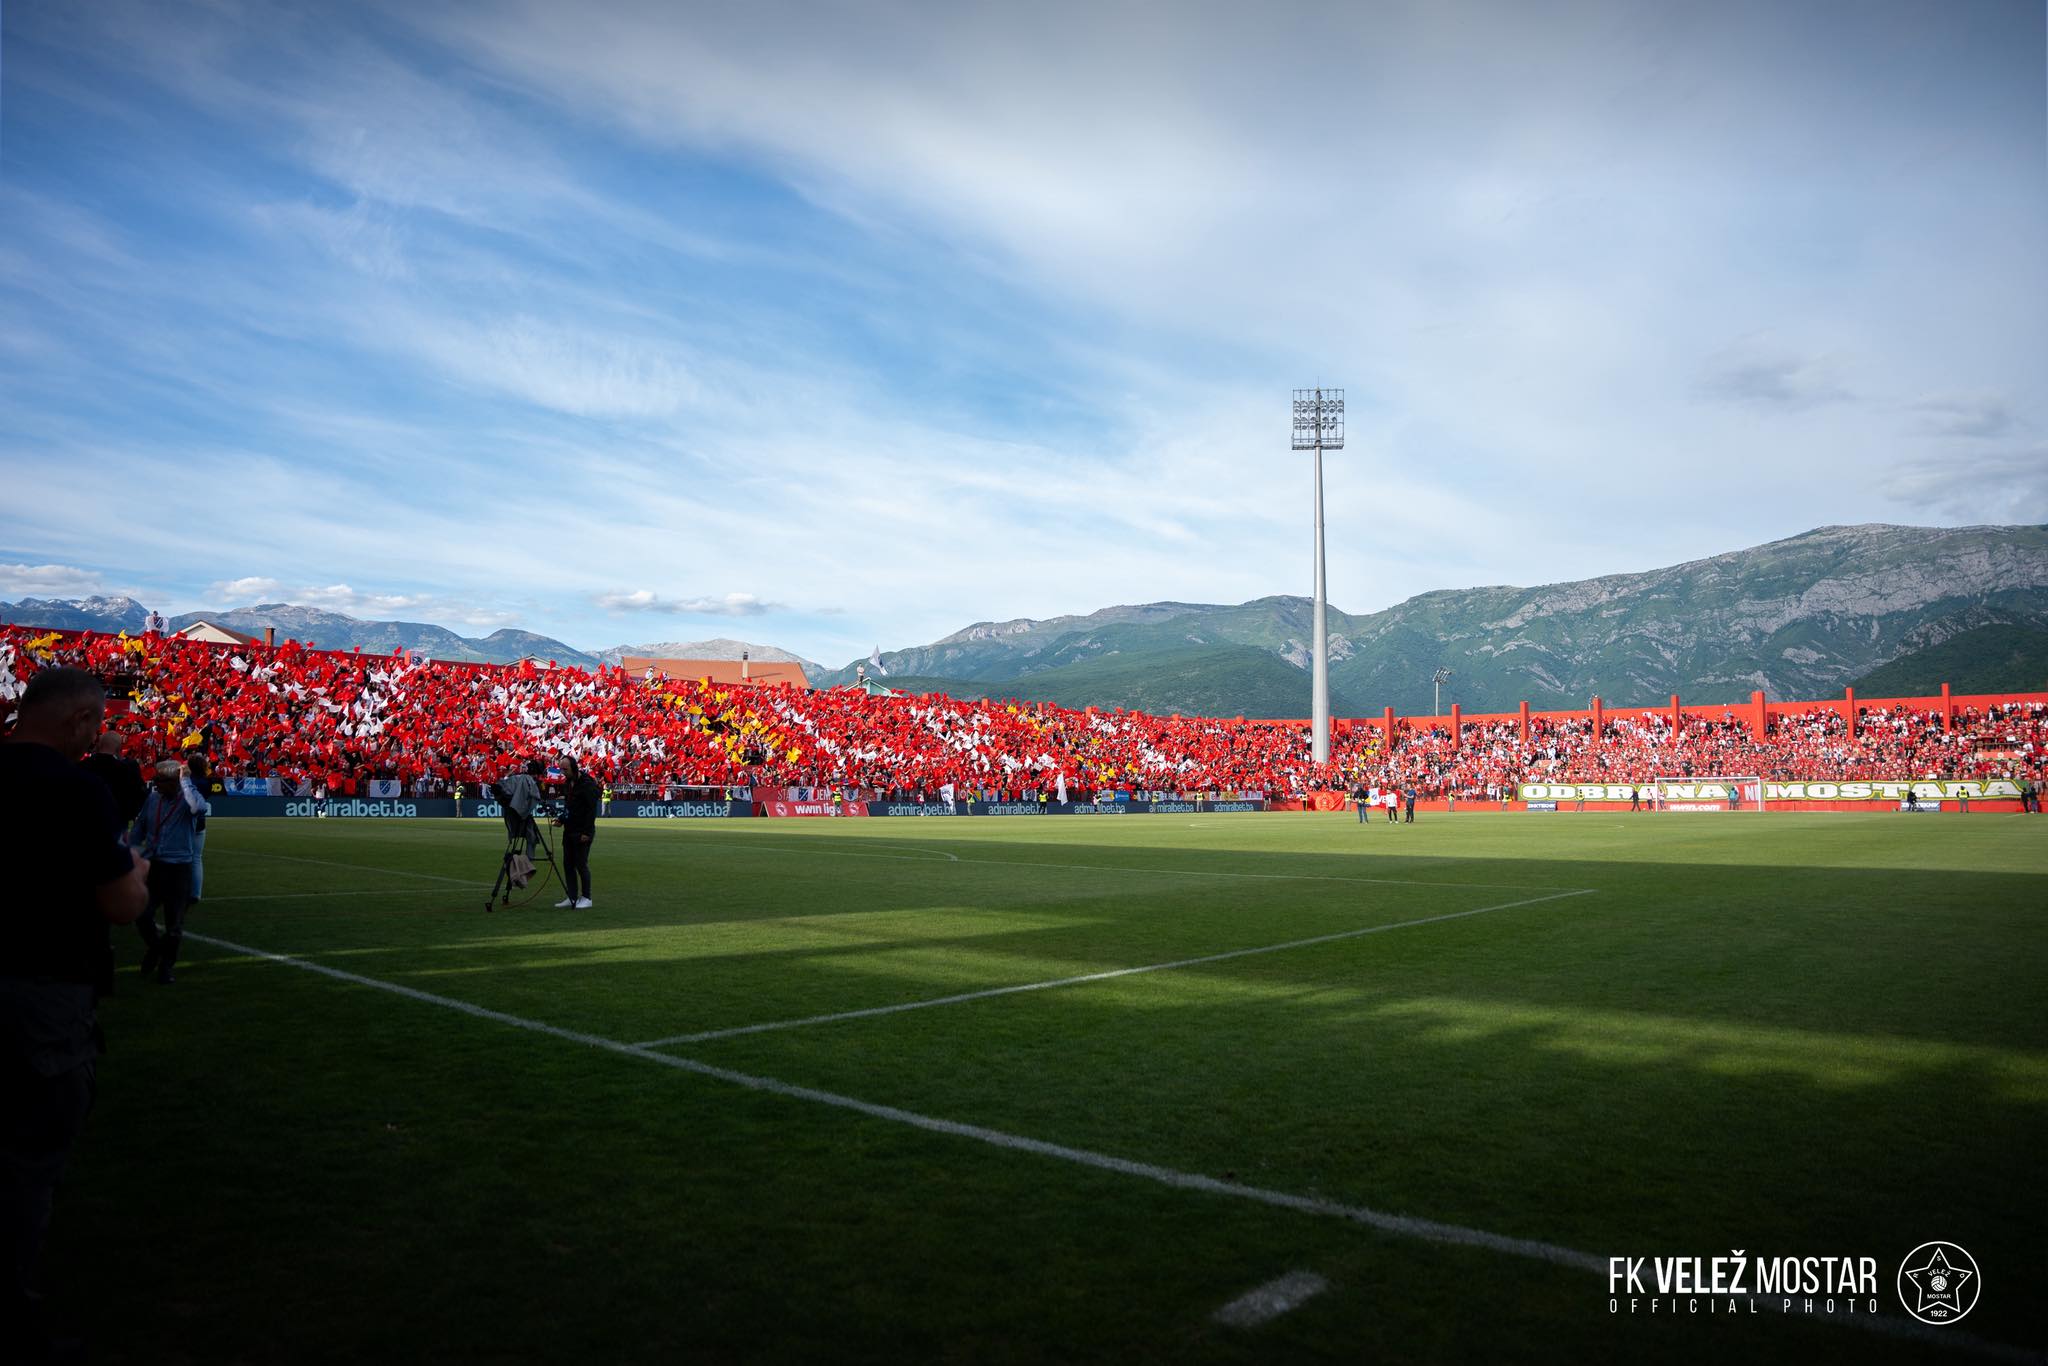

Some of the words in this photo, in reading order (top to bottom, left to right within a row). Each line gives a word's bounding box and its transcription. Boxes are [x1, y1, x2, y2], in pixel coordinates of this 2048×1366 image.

[1521, 783, 1730, 800] ODBRANA
[1765, 780, 2022, 799] MOSTARA
[637, 802, 730, 816] admalbet.ba
[888, 803, 957, 816] admirabet.b
[988, 803, 1047, 815] admiralbet.
[1074, 802, 1126, 814] admilbet.ba
[1149, 803, 1194, 813] amiralbet.ba
